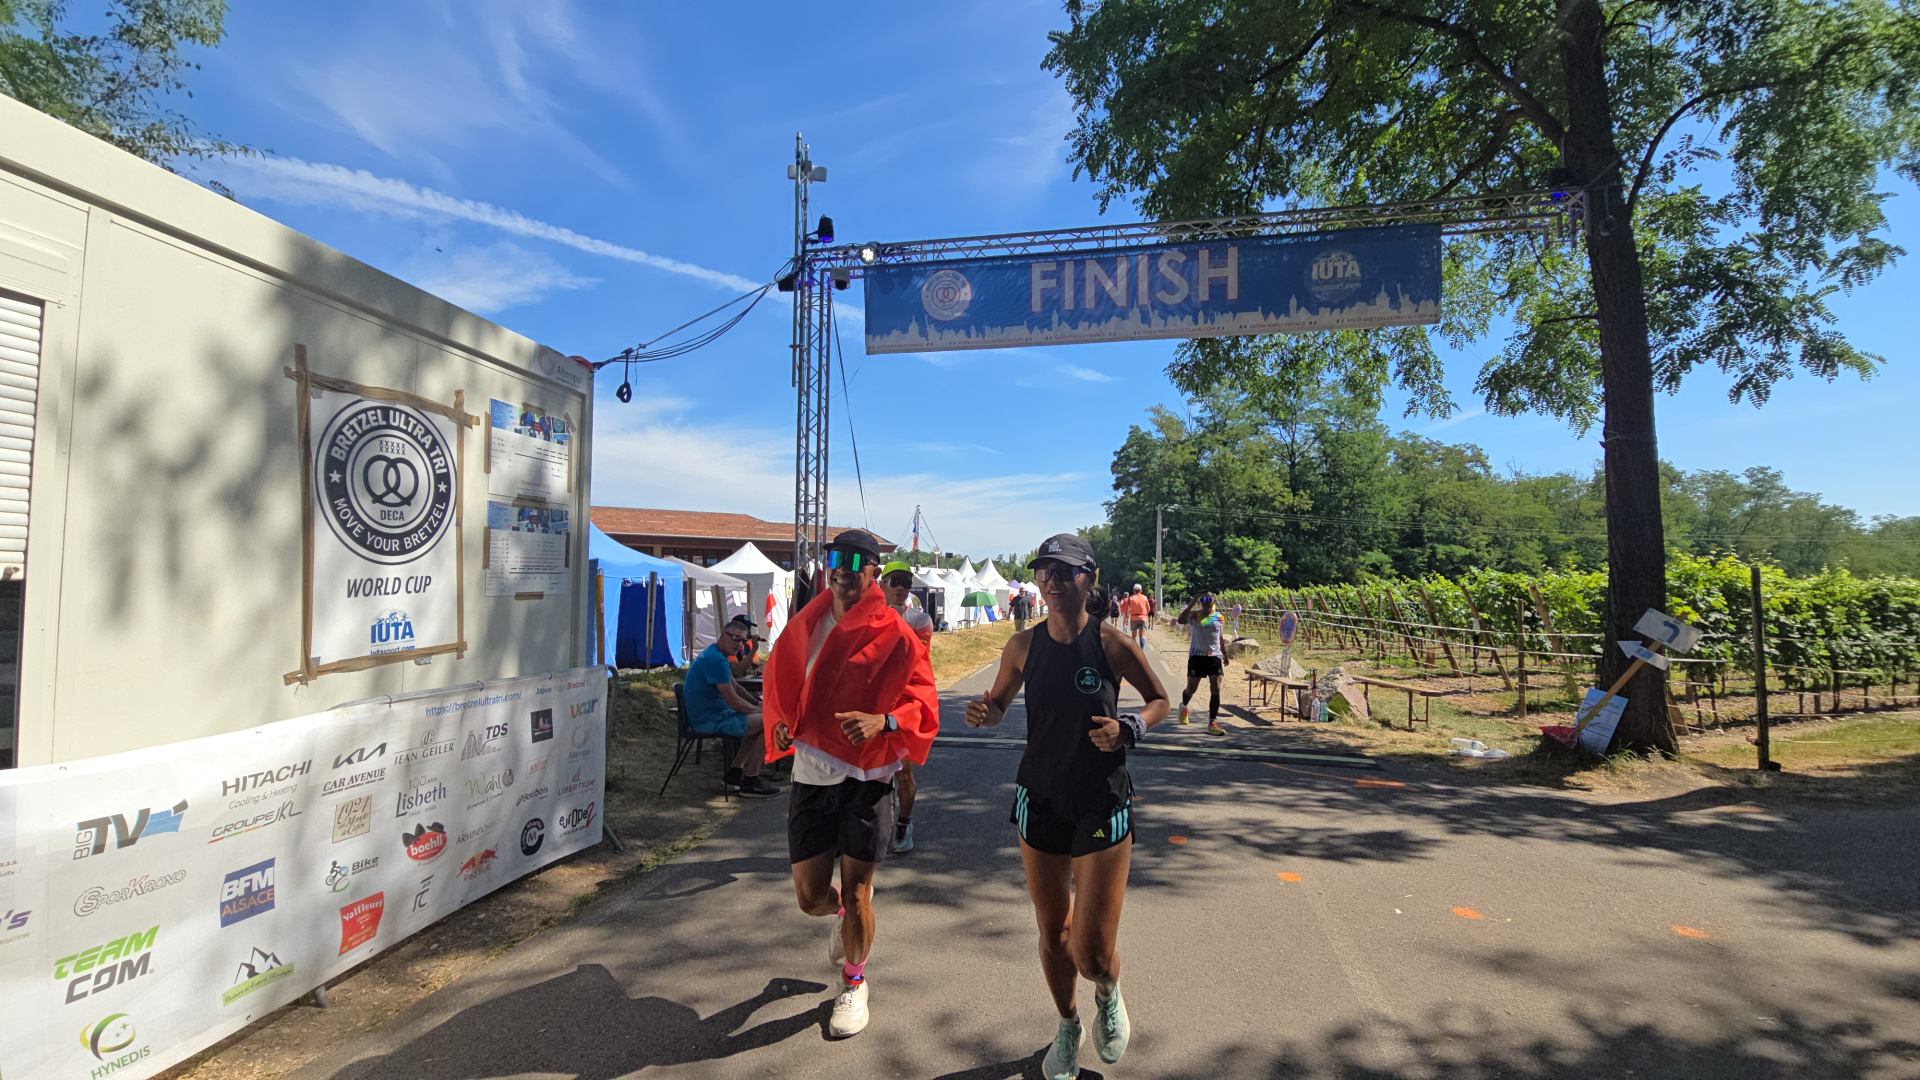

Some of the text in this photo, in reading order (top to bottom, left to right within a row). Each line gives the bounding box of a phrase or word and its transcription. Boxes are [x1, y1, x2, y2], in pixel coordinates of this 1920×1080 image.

[1030, 246, 1240, 313] FINISH
[1311, 259, 1361, 280] IUTA
[331, 409, 387, 462] BRETZEL
[389, 409, 434, 449] ULTRA
[430, 446, 448, 475] TRI
[334, 498, 446, 552] MOVE YOUR BRETZEL
[380, 509, 405, 522] DECA
[346, 575, 432, 598] WORLD CUP
[371, 620, 415, 644] IUTA
[370, 645, 415, 657] iutasportcom
[566, 680, 586, 690] Bretzel
[425, 690, 522, 717] https://bretzelultratri.com/
[570, 698, 599, 719] ucar
[485, 722, 508, 740] TDS
[393, 752, 419, 766] JEAN
[421, 742, 455, 759] GEILER
[222, 759, 313, 798] HITACHI
[323, 768, 386, 792] CAR AVENUE
[228, 784, 298, 810] Cooling & Heating
[394, 782, 446, 819] Lisbeth
[337, 795, 371, 825] 1924
[73, 807, 152, 861] BIG TV
[410, 835, 443, 857] boehli
[528, 831, 537, 843] M
[352, 856, 379, 871] Bike
[463, 864, 492, 883] Red Bull
[220, 866, 274, 903] BFM
[221, 888, 275, 918] ALSACE
[343, 901, 382, 921] Valfleuri
[53, 924, 161, 981] TEAM
[65, 951, 152, 1005] COM
[91, 1045, 152, 1080] HYNEDIS
